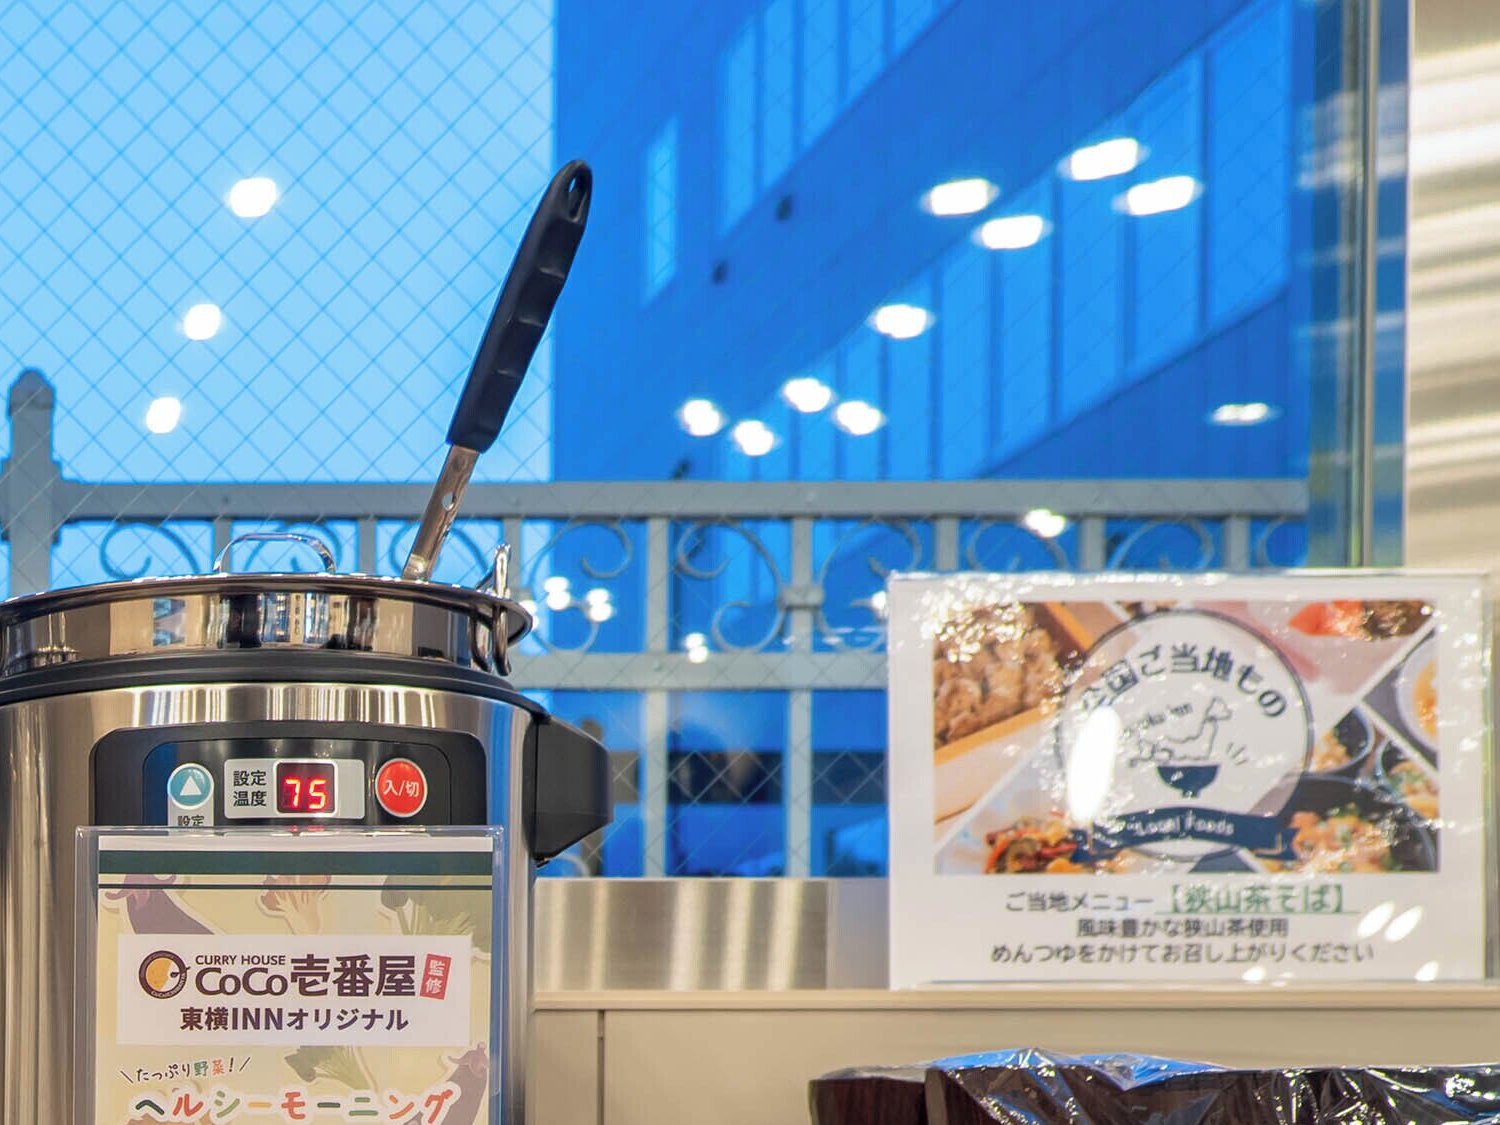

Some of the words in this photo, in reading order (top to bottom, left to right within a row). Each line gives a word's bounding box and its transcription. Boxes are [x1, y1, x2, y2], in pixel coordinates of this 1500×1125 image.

[233, 770, 267, 787] 設定
[383, 779, 420, 797] 入/切
[233, 790, 267, 808] 温度
[285, 779, 328, 809] 75
[1005, 891, 1154, 913] ご当地メニュー
[1076, 918, 1290, 938] 風味豊かな狭山茶使用
[195, 955, 238, 966] CURRY
[241, 955, 287, 966] HOUSE
[990, 943, 1374, 964] めんつゆをかけてお召し上がりください
[426, 958, 446, 996] 監修
[179, 1006, 410, 1032] 東横INNオリジナル
[135, 1088, 454, 1124] ヘルシーモーニング
